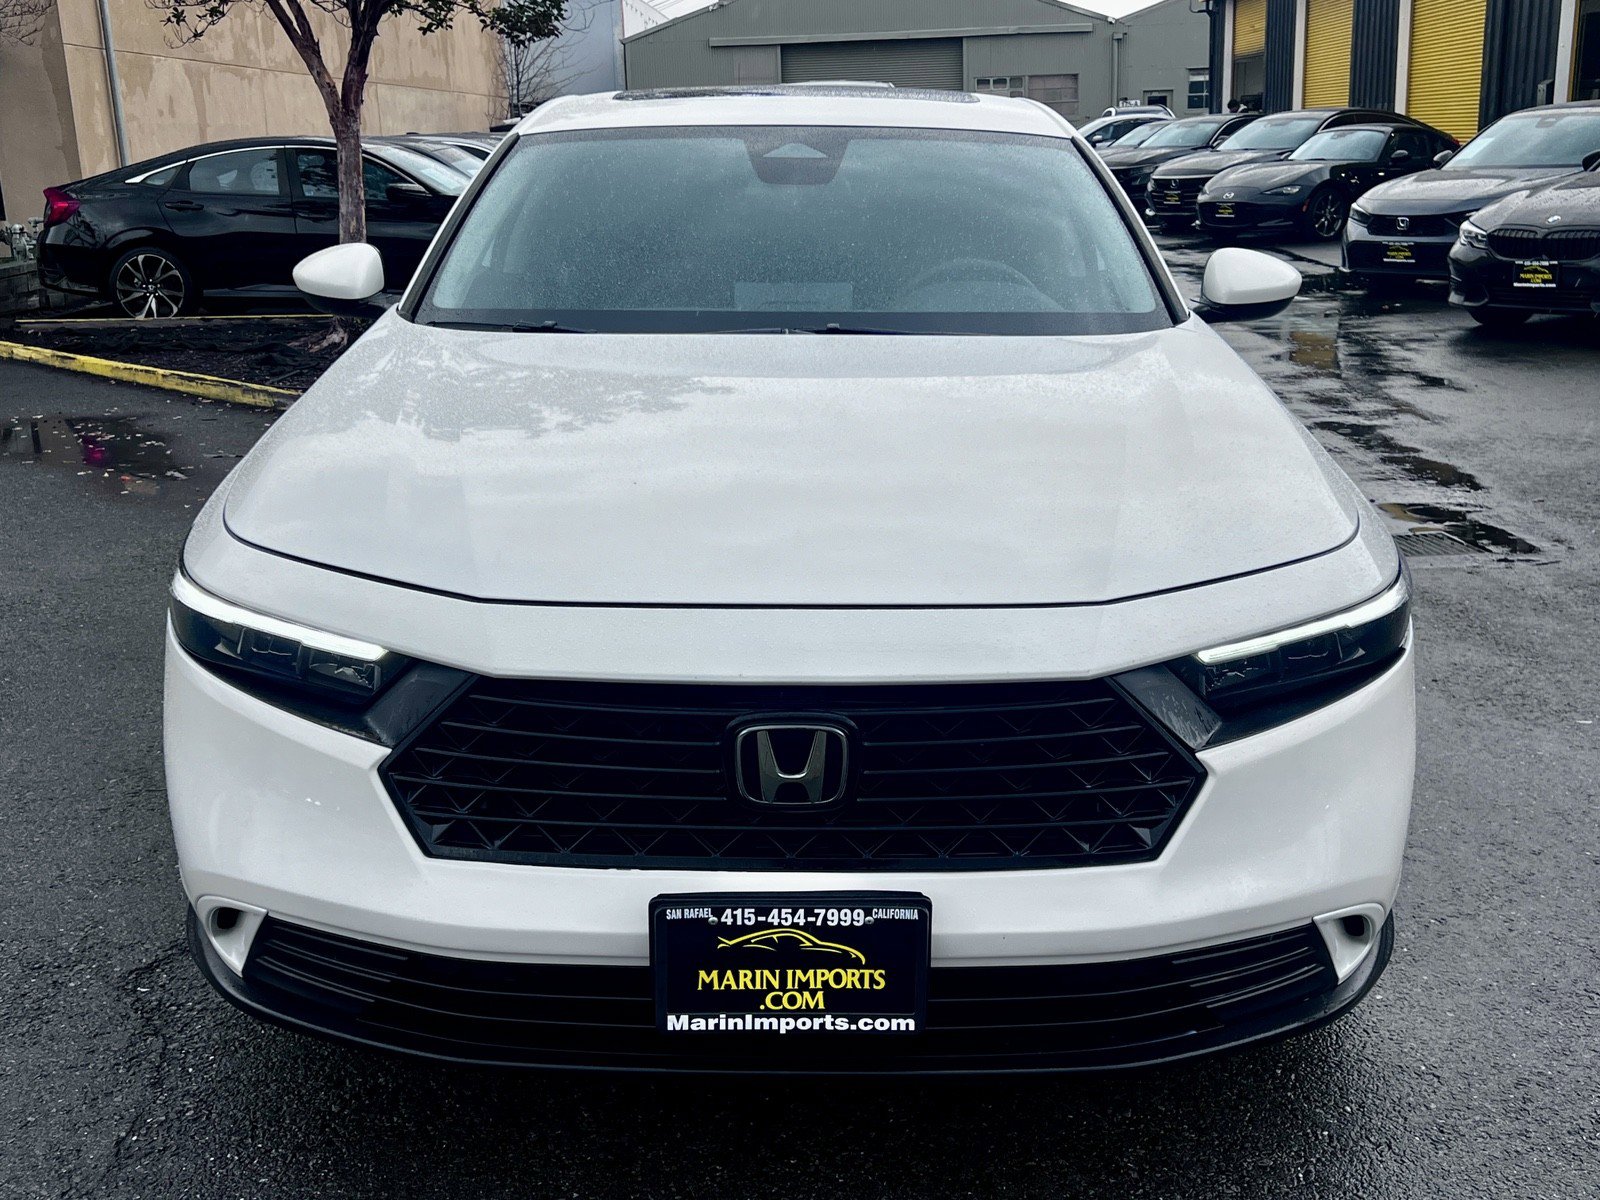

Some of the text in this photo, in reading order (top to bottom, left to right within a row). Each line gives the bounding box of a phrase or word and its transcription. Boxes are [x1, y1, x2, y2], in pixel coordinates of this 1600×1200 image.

[666, 908, 713, 920] SAN RAFAEL
[721, 908, 865, 926] 415-454-7999
[872, 908, 918, 920] CALIFORNIA
[697, 969, 886, 990] MARIN IMPORTS
[760, 991, 825, 1010] .COM
[667, 1015, 915, 1033] MarinImports.com
